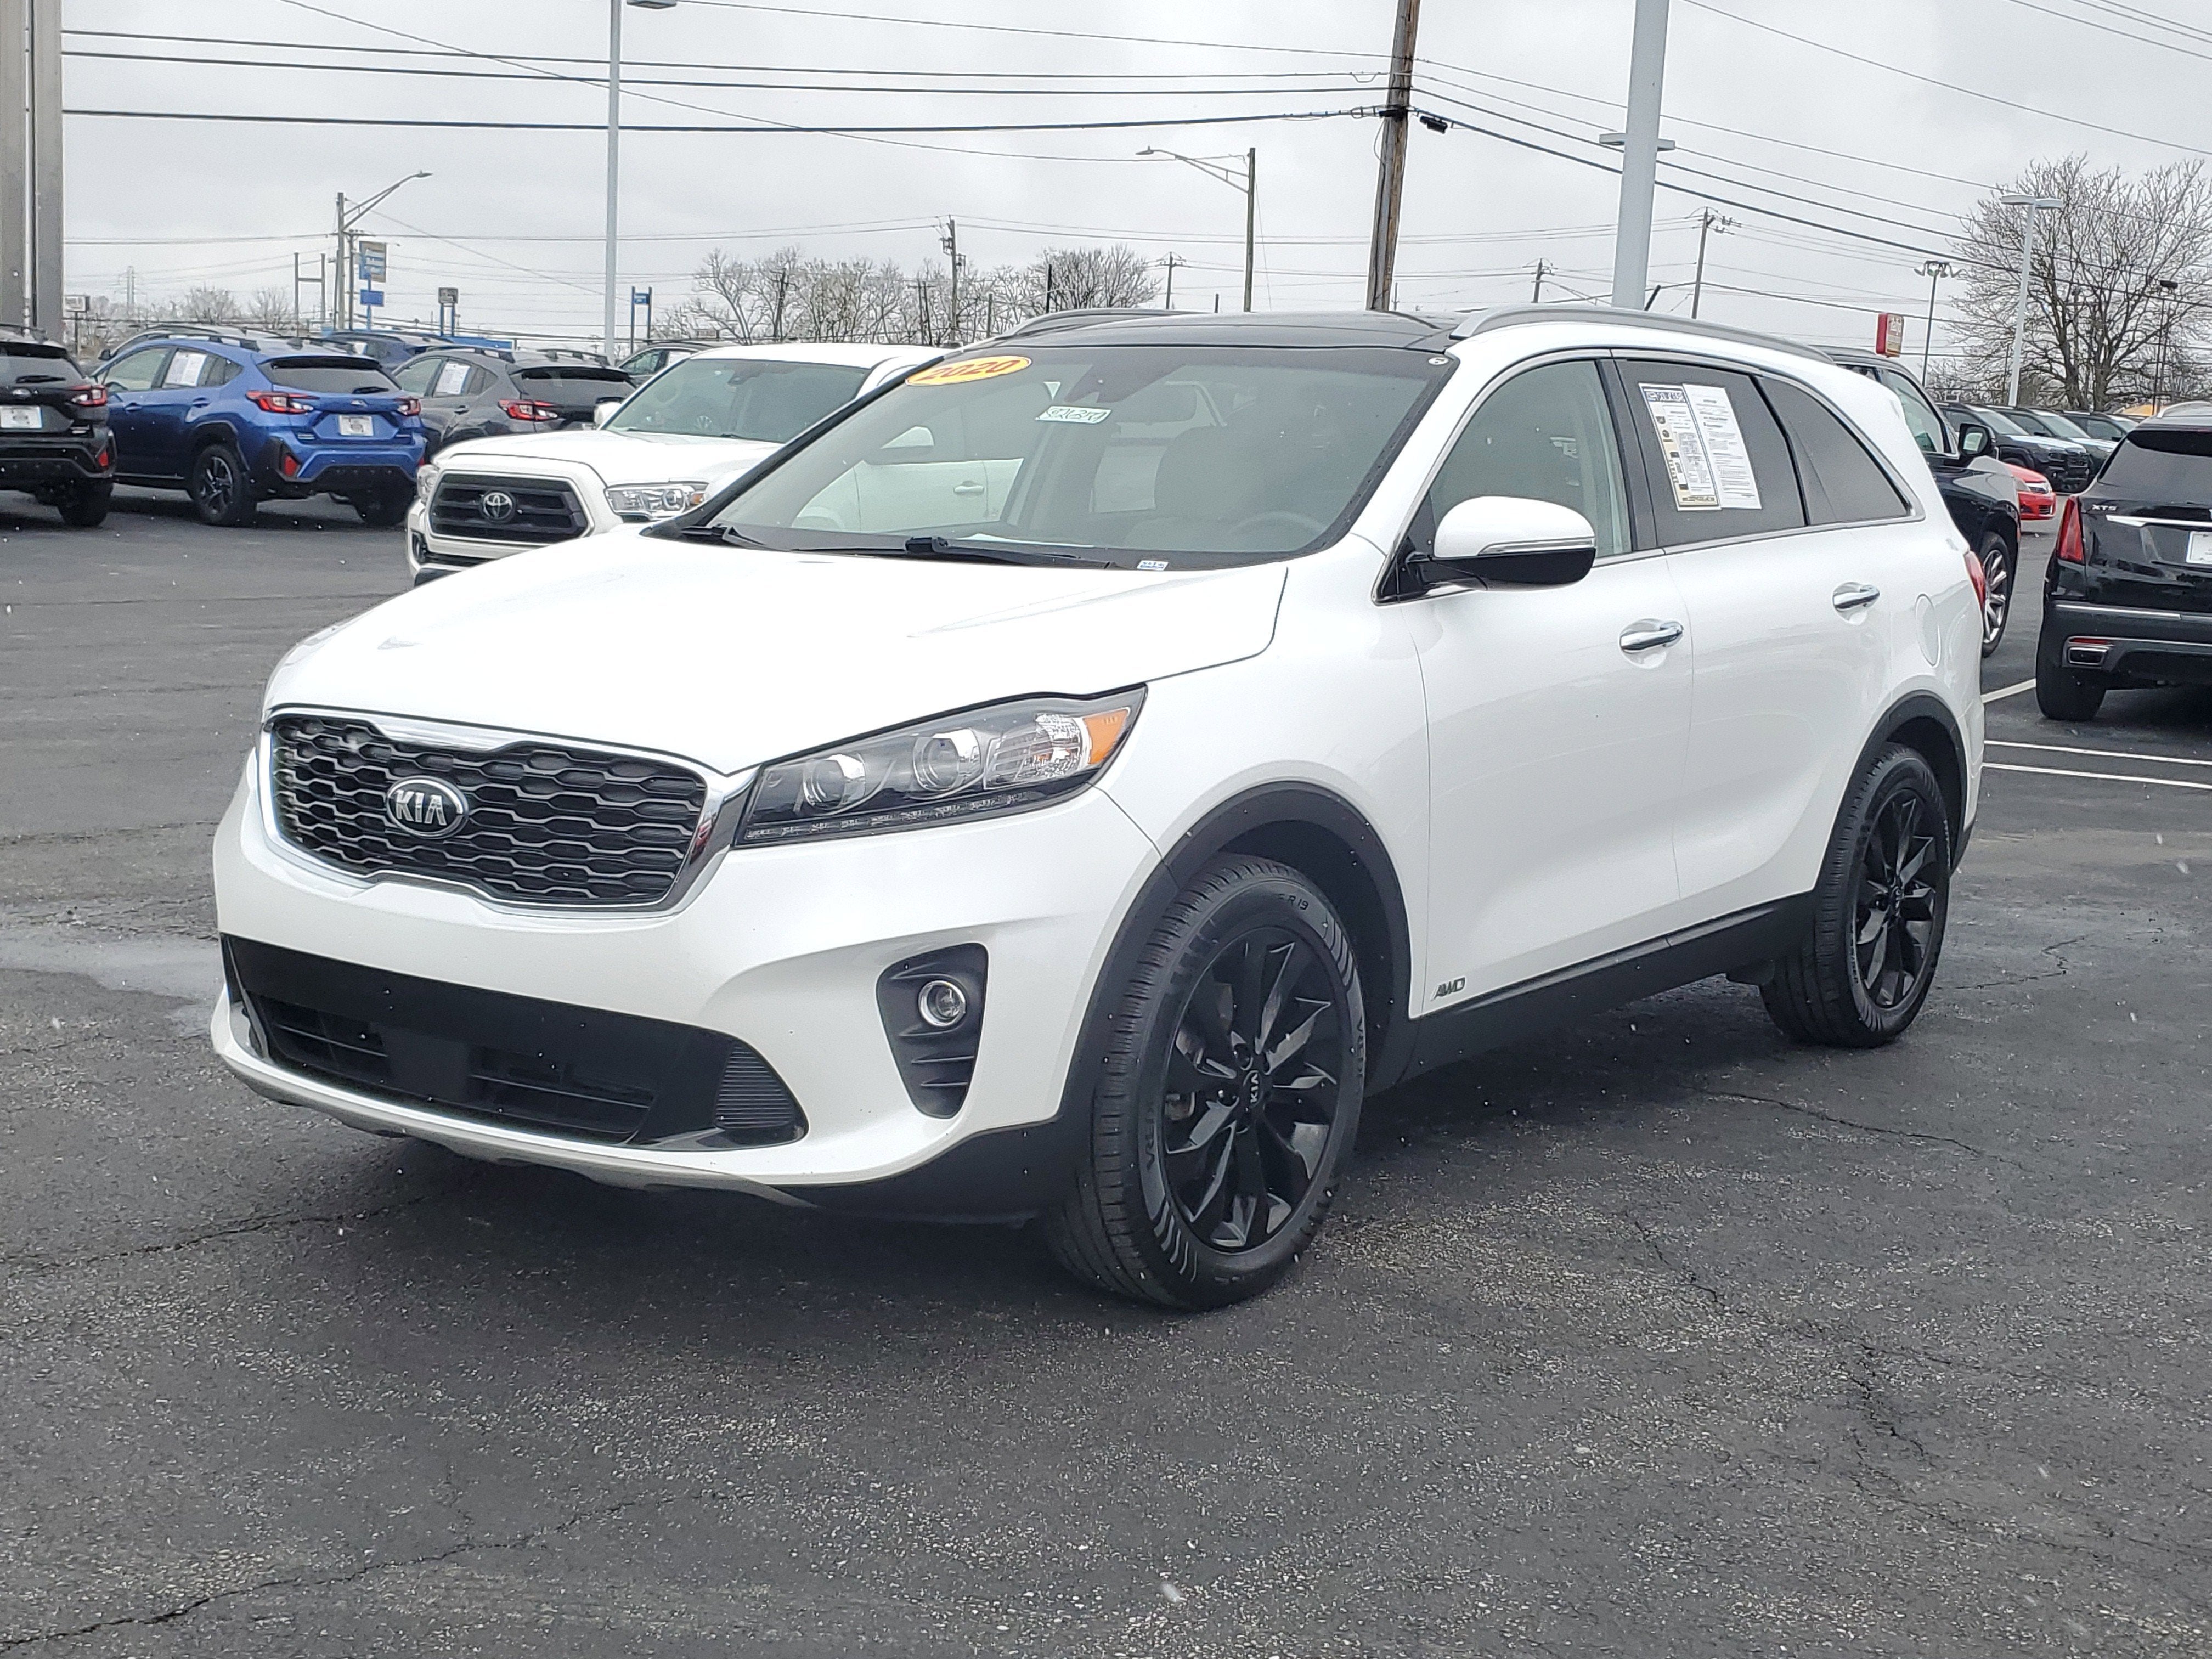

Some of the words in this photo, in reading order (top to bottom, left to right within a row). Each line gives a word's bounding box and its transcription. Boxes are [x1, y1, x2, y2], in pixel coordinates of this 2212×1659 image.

[915, 360, 1020, 382] 2020
[396, 789, 447, 826] KIA
[1430, 977, 1465, 1001] AWD
[1250, 1073, 1259, 1103] KIA
